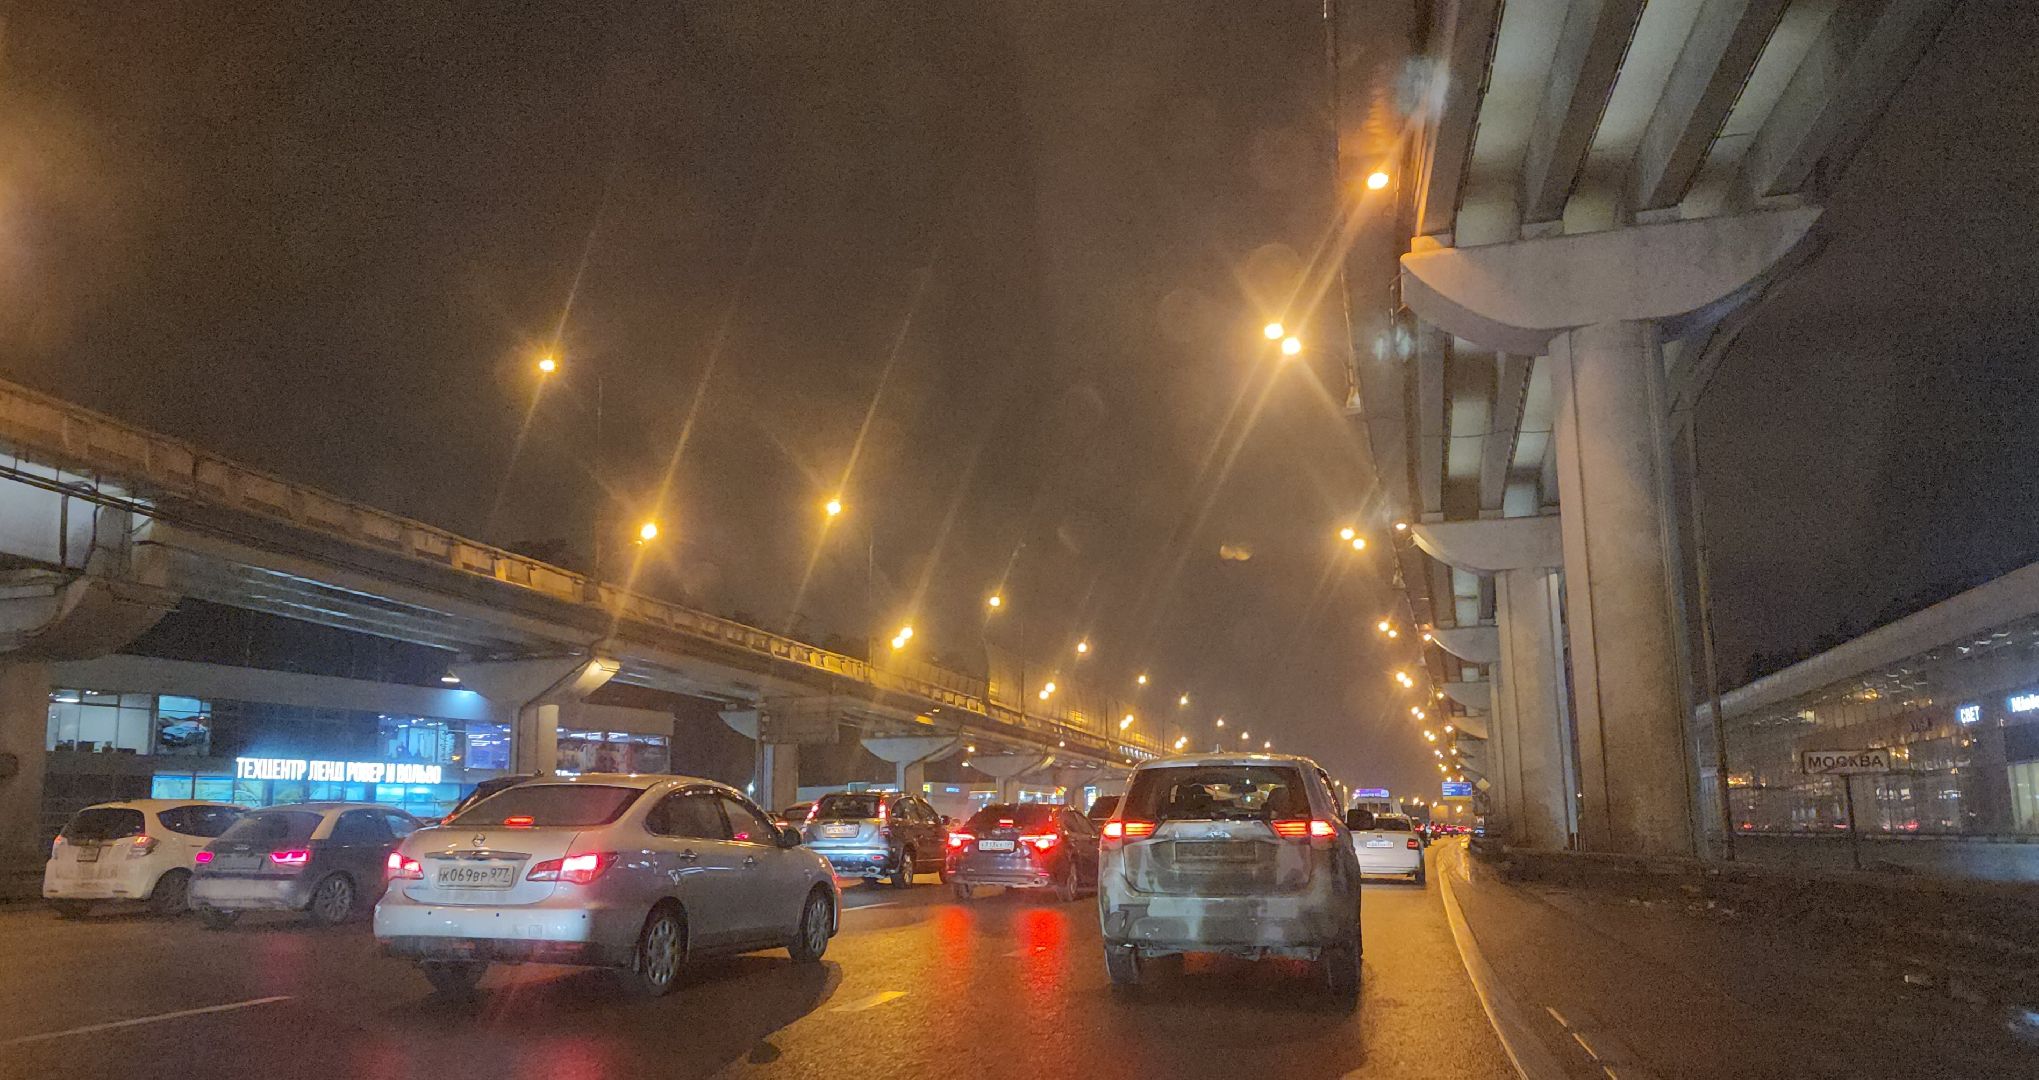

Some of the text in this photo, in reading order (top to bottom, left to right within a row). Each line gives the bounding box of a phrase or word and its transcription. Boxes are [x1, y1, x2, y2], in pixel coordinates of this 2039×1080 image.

[236, 757, 441, 785] ТЕХЦЕНТР ЛЕНД РОВЕР И ВОЛЬВО
[1807, 755, 1884, 769] МОСКВА
